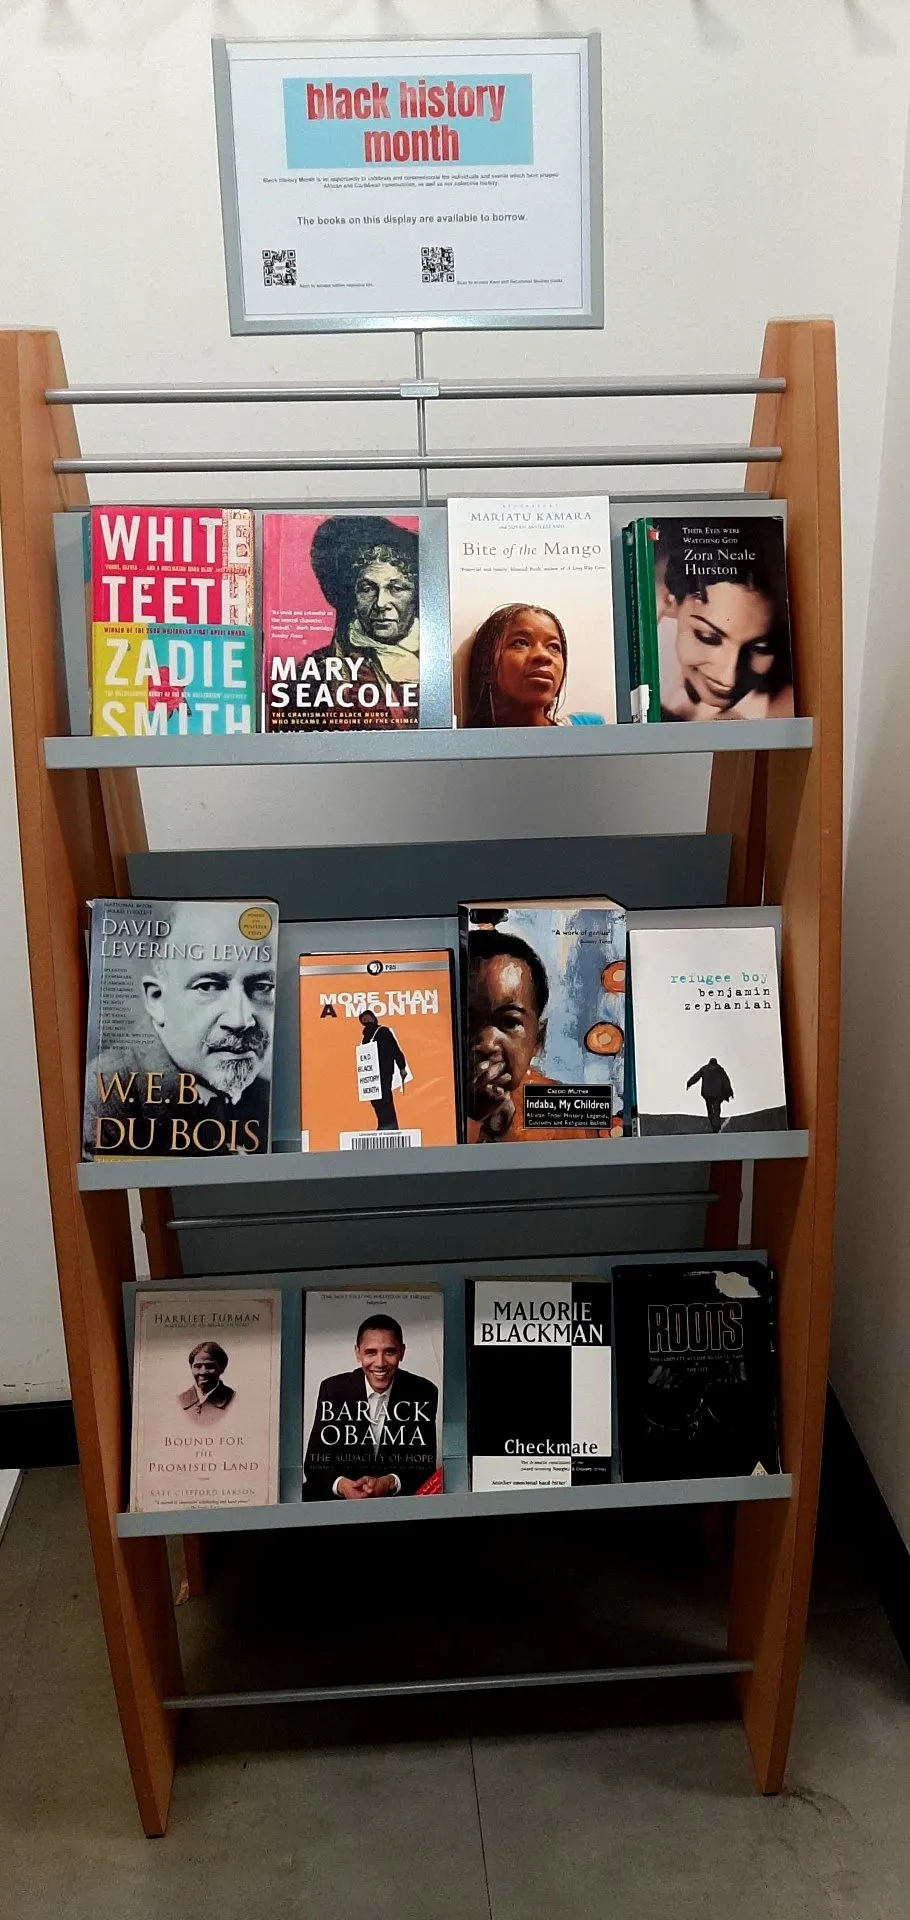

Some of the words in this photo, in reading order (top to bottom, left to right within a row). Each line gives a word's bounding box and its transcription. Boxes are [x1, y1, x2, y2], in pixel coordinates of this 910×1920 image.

[306, 82, 391, 120] black
[399, 79, 506, 121] history
[364, 124, 460, 162] month
[297, 216, 314, 226] The
[317, 215, 346, 225] books
[349, 216, 361, 225] on
[363, 214, 381, 224] this
[383, 213, 417, 226] display
[420, 215, 434, 224] are
[436, 213, 478, 223] available
[480, 213, 490, 222] to
[492, 212, 528, 222] borrow.
[471, 512, 531, 521] MARIATU
[537, 511, 592, 521] KAMARA
[100, 514, 249, 564] WHITE
[463, 542, 497, 556] Bite
[503, 543, 517, 559] of
[520, 543, 537, 556] the
[544, 542, 602, 558] Mango
[684, 548, 713, 560] Zora
[717, 548, 756, 560] Neale
[685, 563, 738, 575] Hurston
[102, 576, 247, 626] TEETH
[105, 638, 247, 688] ZADIE
[271, 656, 365, 681] MARY
[271, 683, 419, 708] SEACOLE
[102, 701, 250, 736] SMITH
[101, 918, 171, 937] DAVID
[100, 940, 204, 961] LEVERING
[211, 943, 272, 962] LEWIS
[671, 974, 731, 985] refugee
[741, 972, 769, 985] boy
[320, 992, 379, 1005] MORE
[385, 990, 438, 1004] THAN
[698, 987, 771, 998] benjamin
[320, 1004, 337, 1018] A
[345, 1001, 438, 1017] MONTH
[684, 1000, 772, 1012] zephaniah
[360, 1075, 379, 1083] HISTORY
[526, 1099, 557, 1110] Indaba,
[558, 1099, 571, 1111] My
[573, 1099, 610, 1109] Children
[94, 1117, 156, 1150] DU
[170, 1118, 260, 1152] BOIS
[154, 1314, 205, 1323] HARRIET
[212, 1312, 260, 1322] TUBMAN
[493, 1301, 592, 1321] MALORIE
[481, 1323, 603, 1344] BLACKMAN
[648, 1302, 744, 1353] ROOTS
[320, 1400, 431, 1424] BARACK
[164, 1437, 214, 1447] BOUND
[219, 1436, 245, 1446] FOR
[320, 1425, 426, 1446] OBAMA
[504, 1439, 598, 1454] Checkmate
[310, 1453, 331, 1462] THE
[335, 1453, 384, 1463] AUDACITY
[389, 1453, 401, 1462] OF
[405, 1453, 434, 1463] HOPE
[149, 1462, 217, 1473] PROMISED
[223, 1461, 259, 1471] LAND
